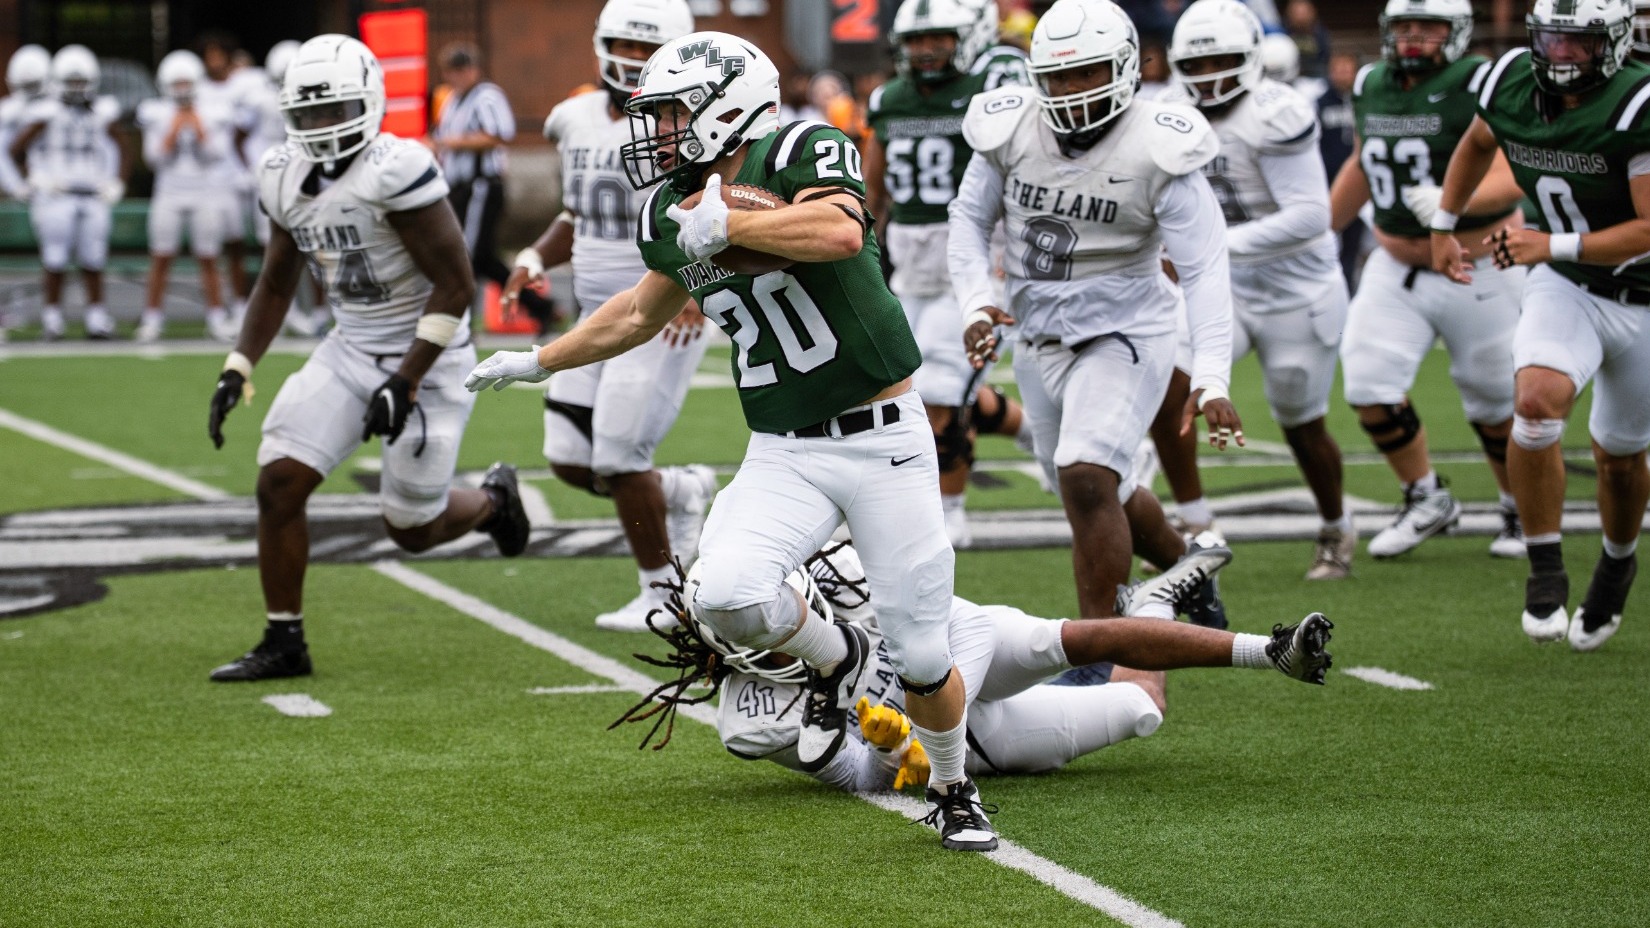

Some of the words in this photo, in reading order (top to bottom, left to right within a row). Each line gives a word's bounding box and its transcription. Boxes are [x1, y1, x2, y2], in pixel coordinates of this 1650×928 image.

[831, 0, 878, 42] 2
[677, 40, 745, 77] WLC
[984, 95, 1023, 115] 8
[1154, 112, 1194, 134] 8
[813, 139, 864, 182] 20
[884, 138, 956, 205] 58
[1361, 137, 1436, 210] 63
[1504, 140, 1609, 174] WARRIORS
[730, 188, 776, 209] Wilson
[1013, 178, 1048, 212] THE
[1052, 190, 1118, 223] LAND
[1536, 175, 1590, 234] 0
[1020, 214, 1079, 281] 8
[701, 268, 840, 391] 20
[737, 680, 776, 718] 41
